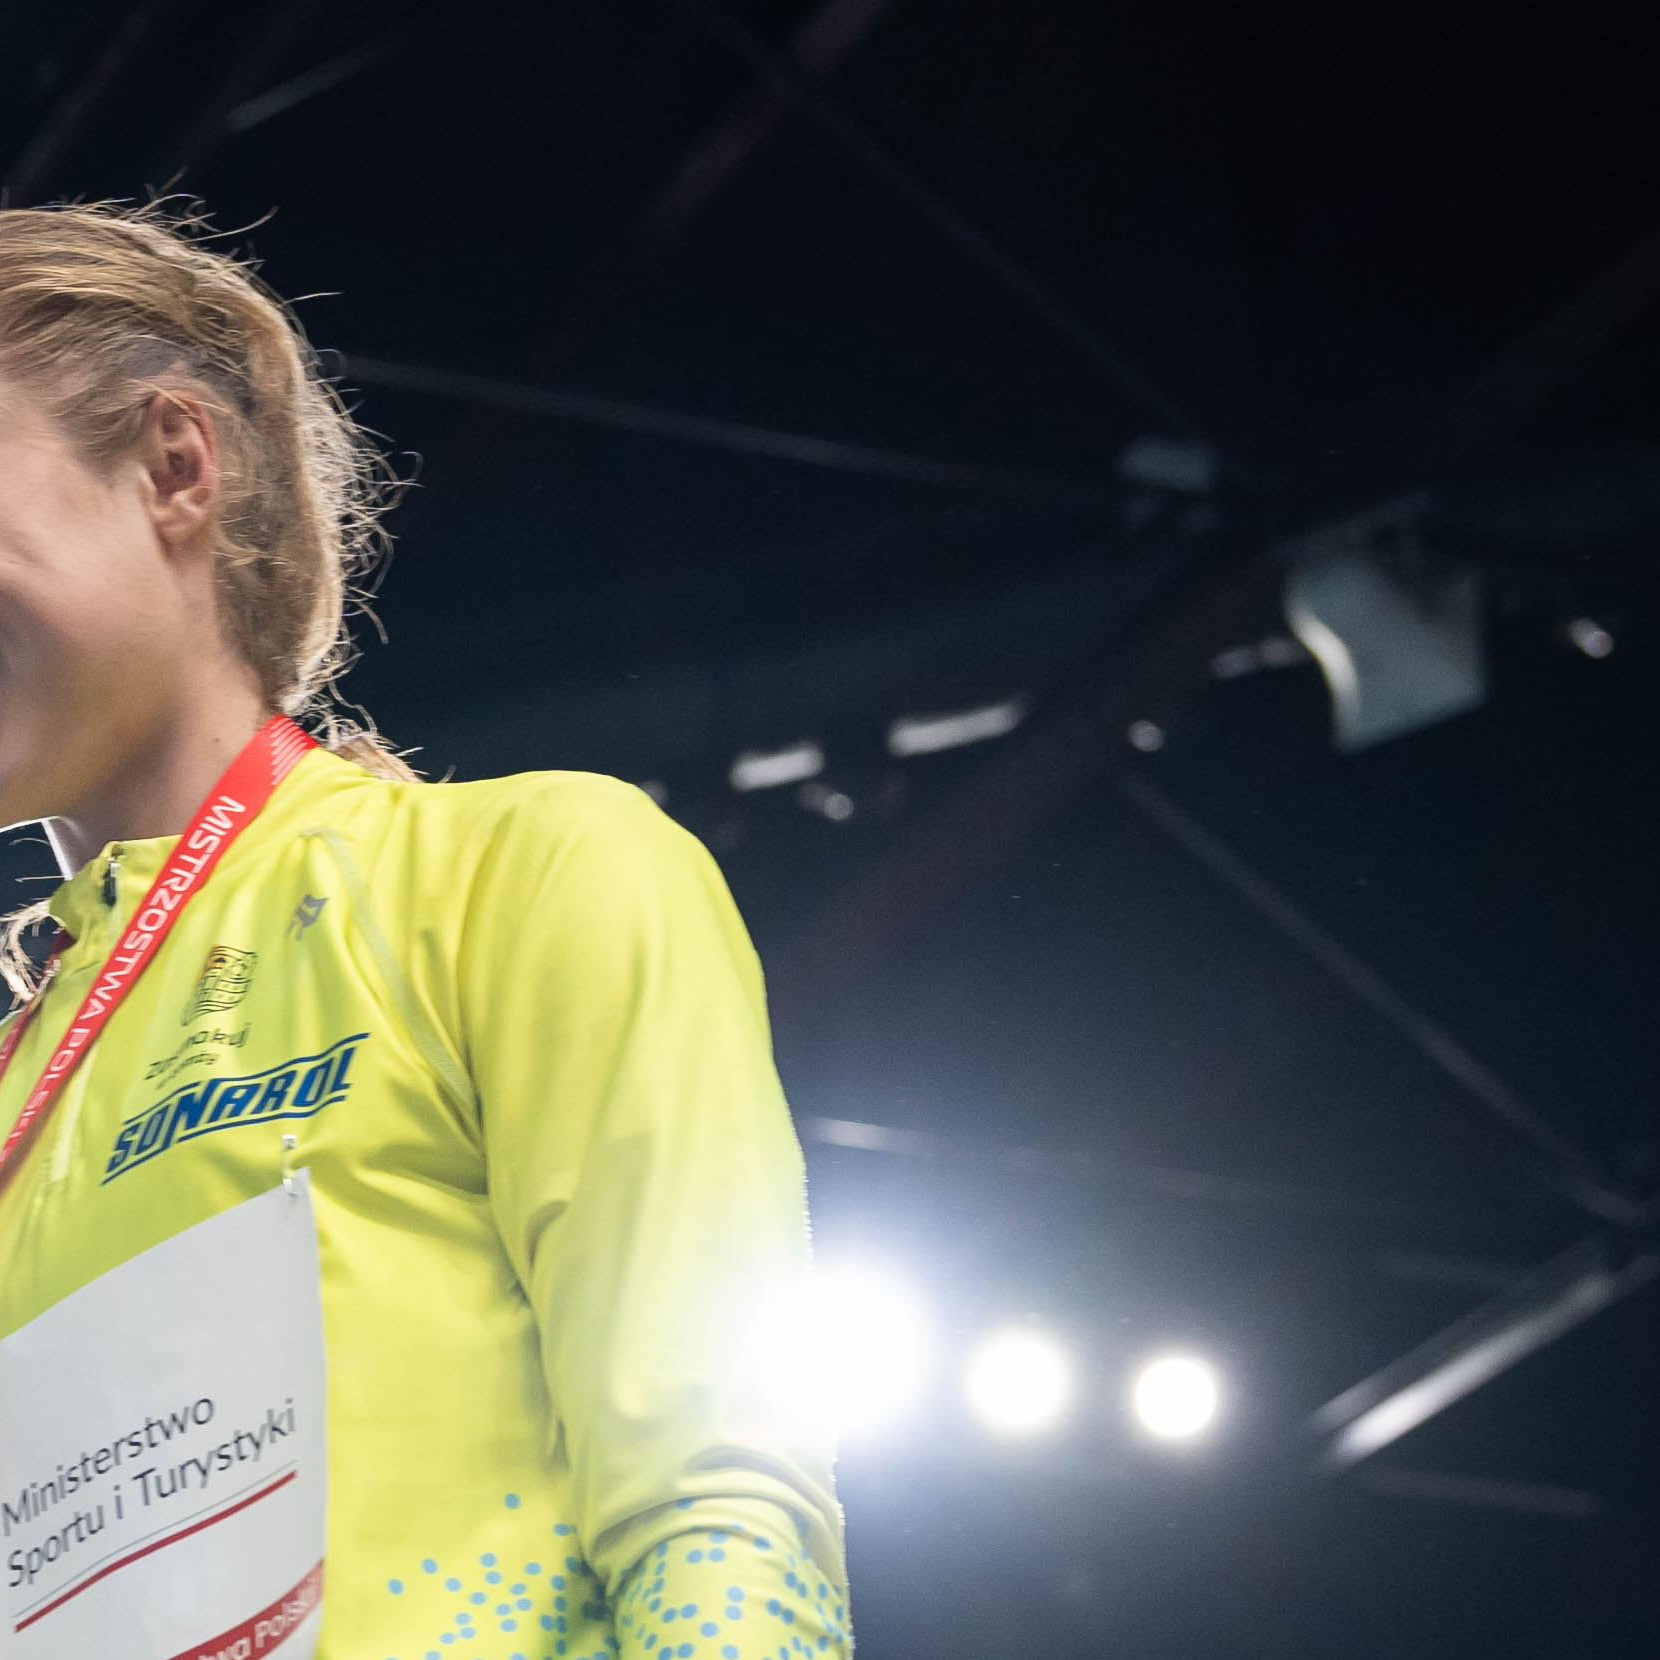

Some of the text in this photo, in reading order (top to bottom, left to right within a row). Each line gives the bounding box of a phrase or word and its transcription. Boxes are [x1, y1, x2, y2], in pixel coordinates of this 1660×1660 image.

[79, 795, 247, 1021] MISTRZOSTWA
[106, 1046, 358, 1174] SONAROL
[1, 1398, 215, 1537] Ministerstwo
[7, 1397, 296, 1588] Sportu i Turystyki
